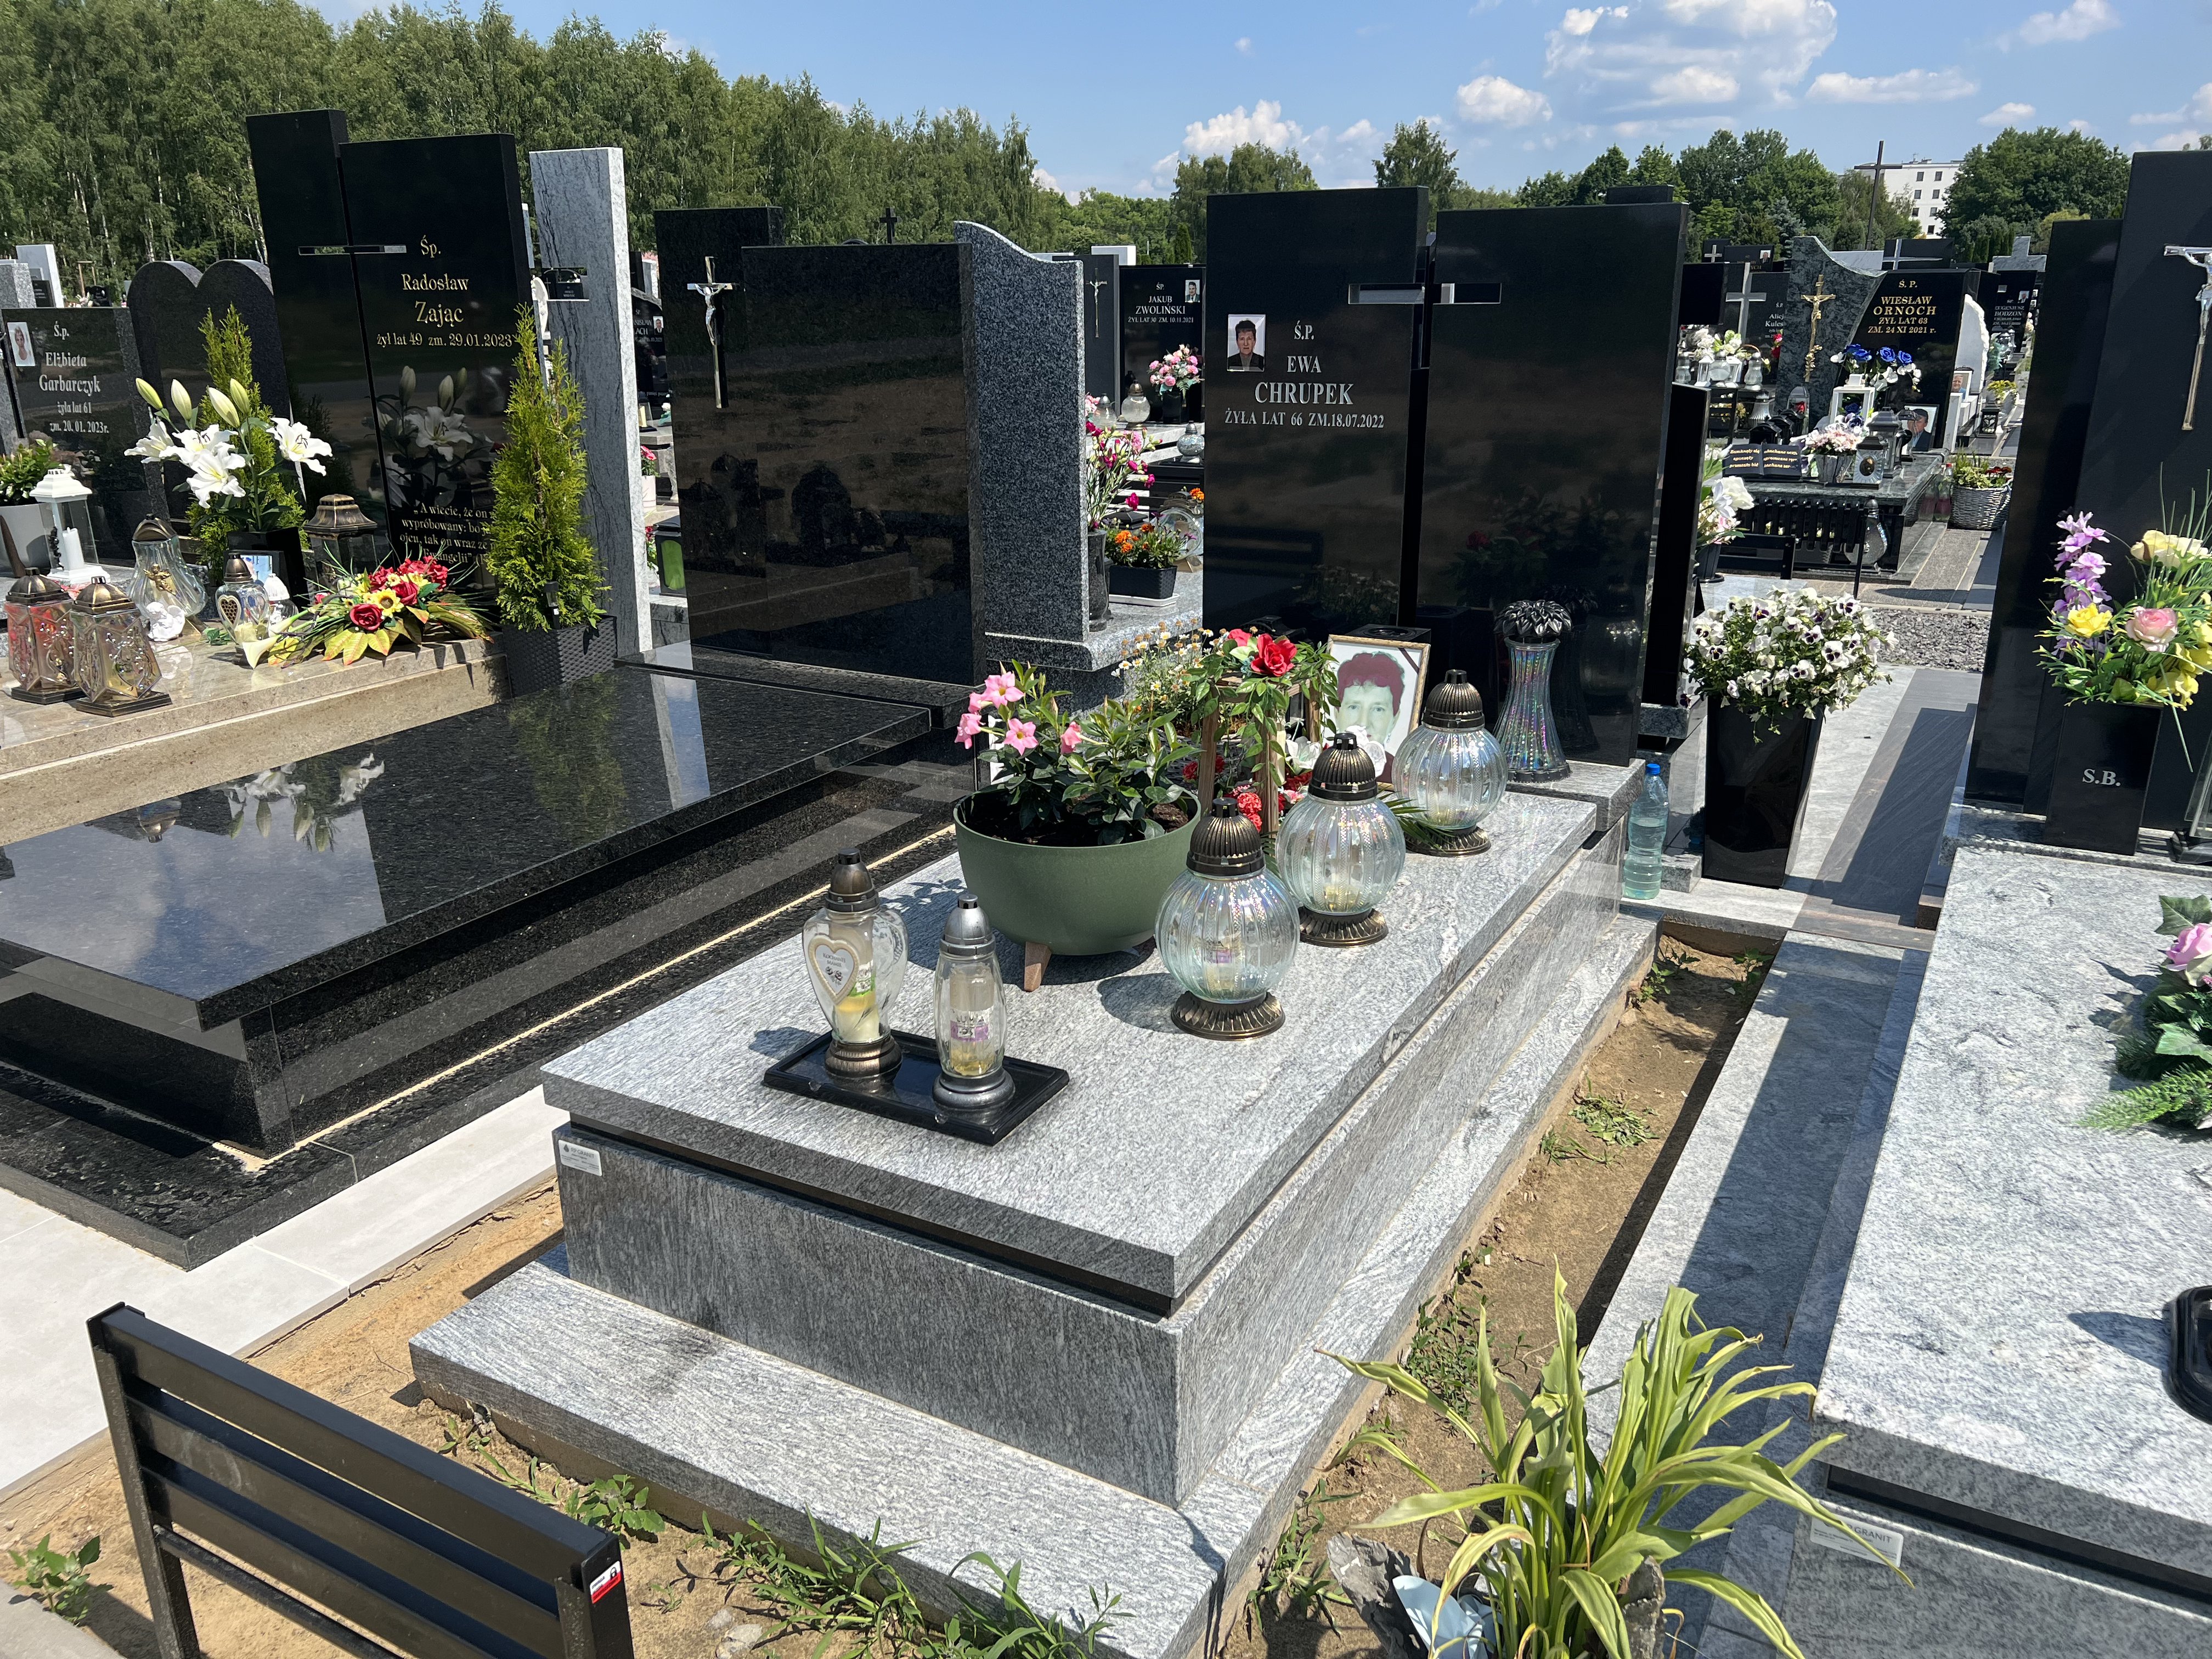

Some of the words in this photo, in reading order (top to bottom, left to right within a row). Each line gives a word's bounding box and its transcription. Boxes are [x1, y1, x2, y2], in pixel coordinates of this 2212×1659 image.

[420, 234, 441, 258] Śp.
[402, 273, 469, 291] Radosław
[1135, 303, 1186, 314] ZWOLIŃSKI
[1881, 296, 1933, 304] WIESŁAW
[414, 301, 464, 328] Zając
[1873, 306, 1937, 315] ORNOCH
[1293, 320, 1314, 340] Ś.P.
[377, 332, 392, 348] żył
[393, 332, 408, 346] lat
[409, 332, 423, 346] 49
[428, 336, 447, 346] zm.
[449, 333, 512, 347] 29.01.2023
[45, 352, 87, 368] Elżbieta
[1286, 355, 1322, 374] EWA
[39, 374, 101, 397] Garbarczyk
[1254, 381, 1355, 405] CHRUPEK
[57, 400, 71, 416] żyła
[72, 401, 82, 413] lat
[83, 402, 92, 414] 61
[1224, 407, 1257, 425] ŻYŁA
[1262, 411, 1286, 426] LAT
[1291, 412, 1303, 426] 66
[429, 505, 461, 518] wiecie,
[464, 507, 473, 517] że
[476, 510, 488, 518] on
[402, 518, 467, 534] wypróbowany:
[469, 522, 480, 533] bo
[424, 534, 438, 545] tak
[454, 539, 476, 549] wraz
[478, 541, 488, 550] ze
[2081, 768, 2122, 787] S.B.
[1854, 1526, 1892, 1543] GRANIT
